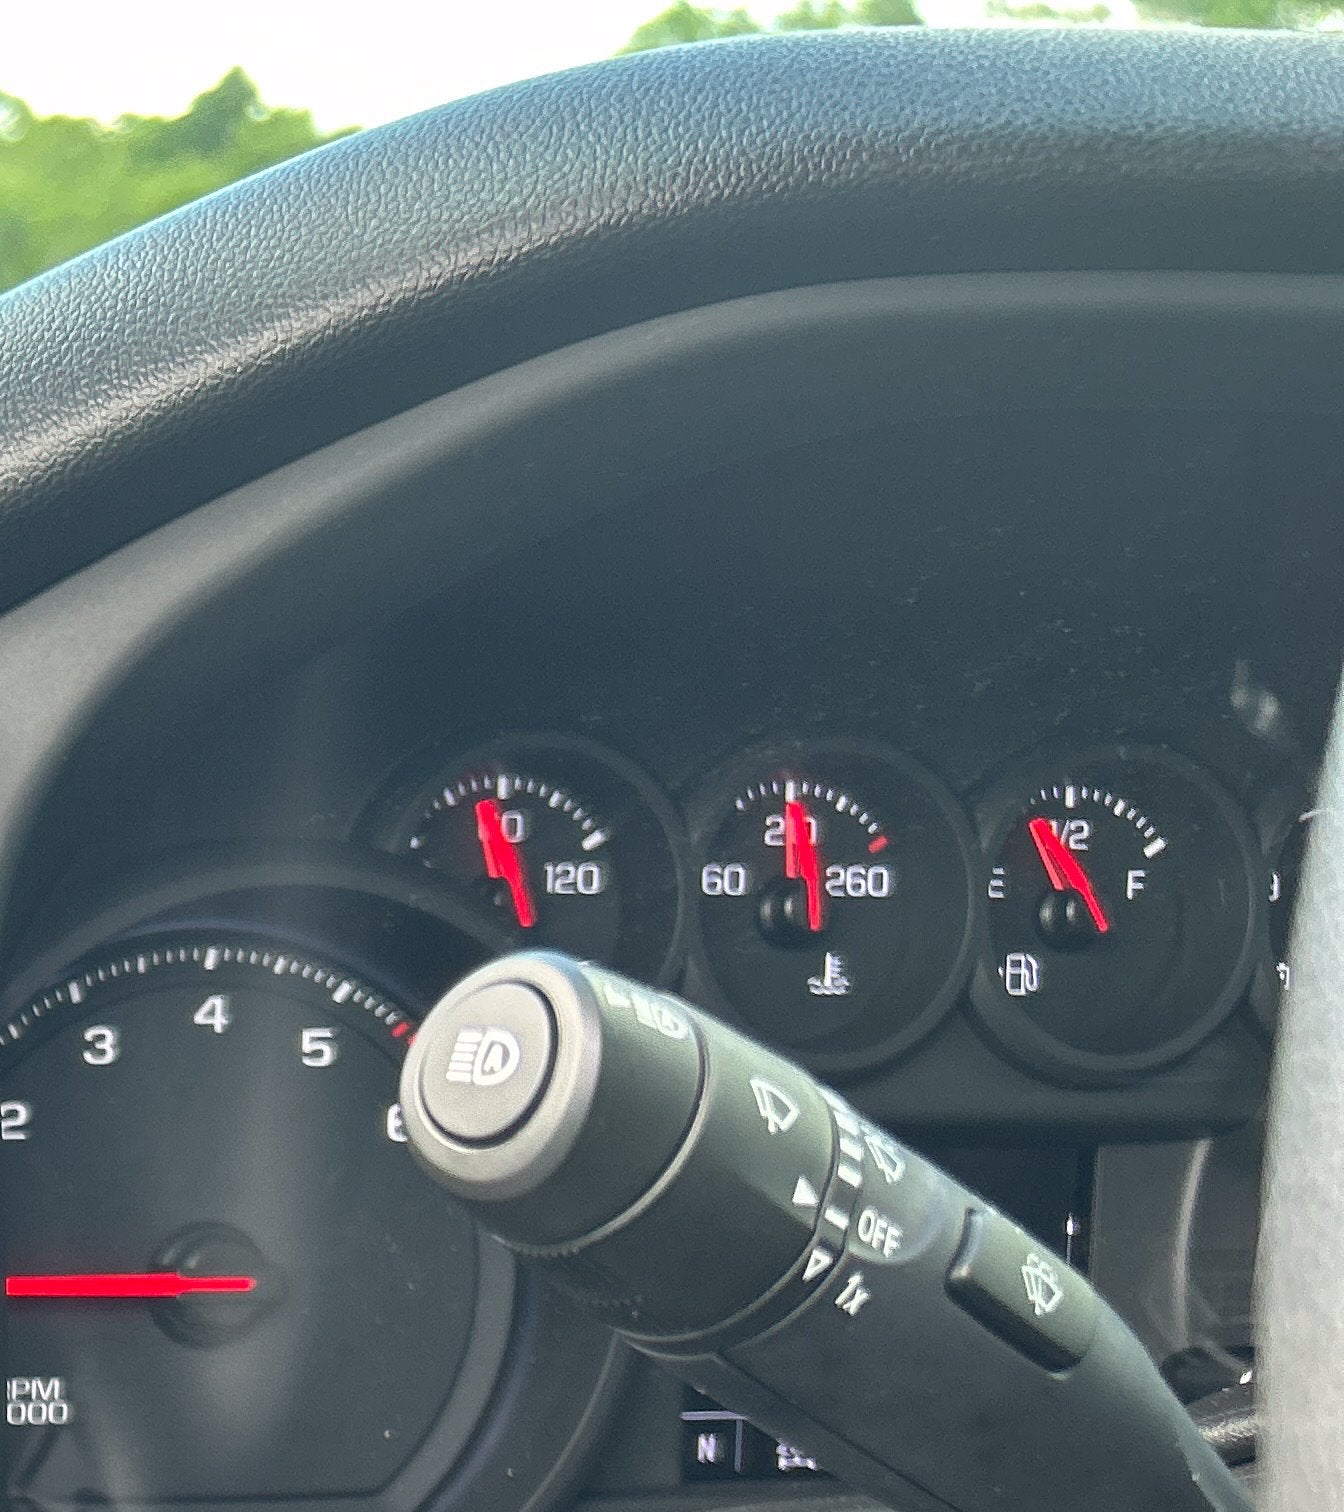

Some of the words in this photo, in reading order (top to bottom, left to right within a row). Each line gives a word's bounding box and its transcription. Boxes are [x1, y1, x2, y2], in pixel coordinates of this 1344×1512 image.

[543, 861, 603, 896] 120
[824, 864, 892, 898] 260
[1125, 868, 1148, 901] F
[193, 993, 231, 1035] 4
[82, 1024, 120, 1066] 3
[300, 1026, 337, 1068] 5
[0, 1100, 28, 1141] 2
[857, 1205, 903, 1258] OFF
[6, 1376, 61, 1401] PM
